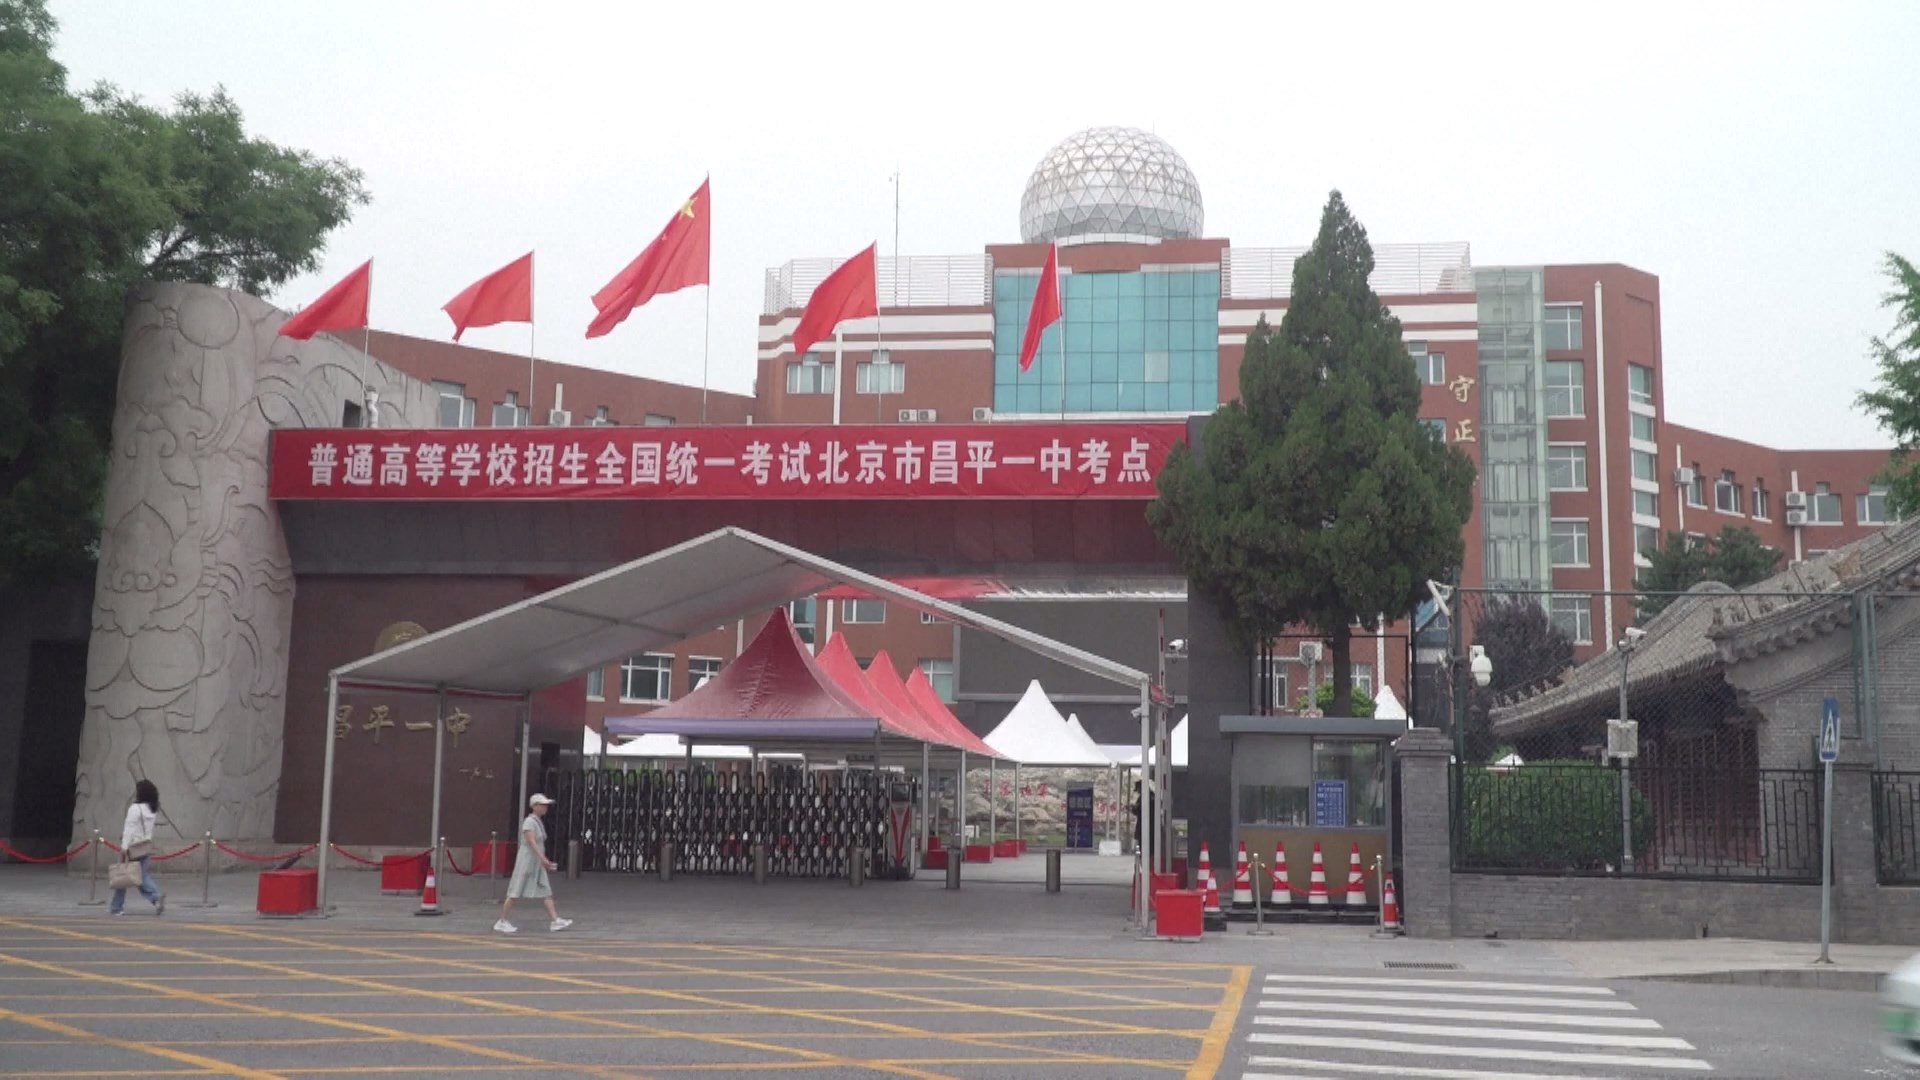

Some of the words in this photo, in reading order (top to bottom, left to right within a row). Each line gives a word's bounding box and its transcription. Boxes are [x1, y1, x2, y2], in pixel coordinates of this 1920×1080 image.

[308, 437, 1152, 486] 普通高等学校招生全国统一考试北京市昌平一中考点
